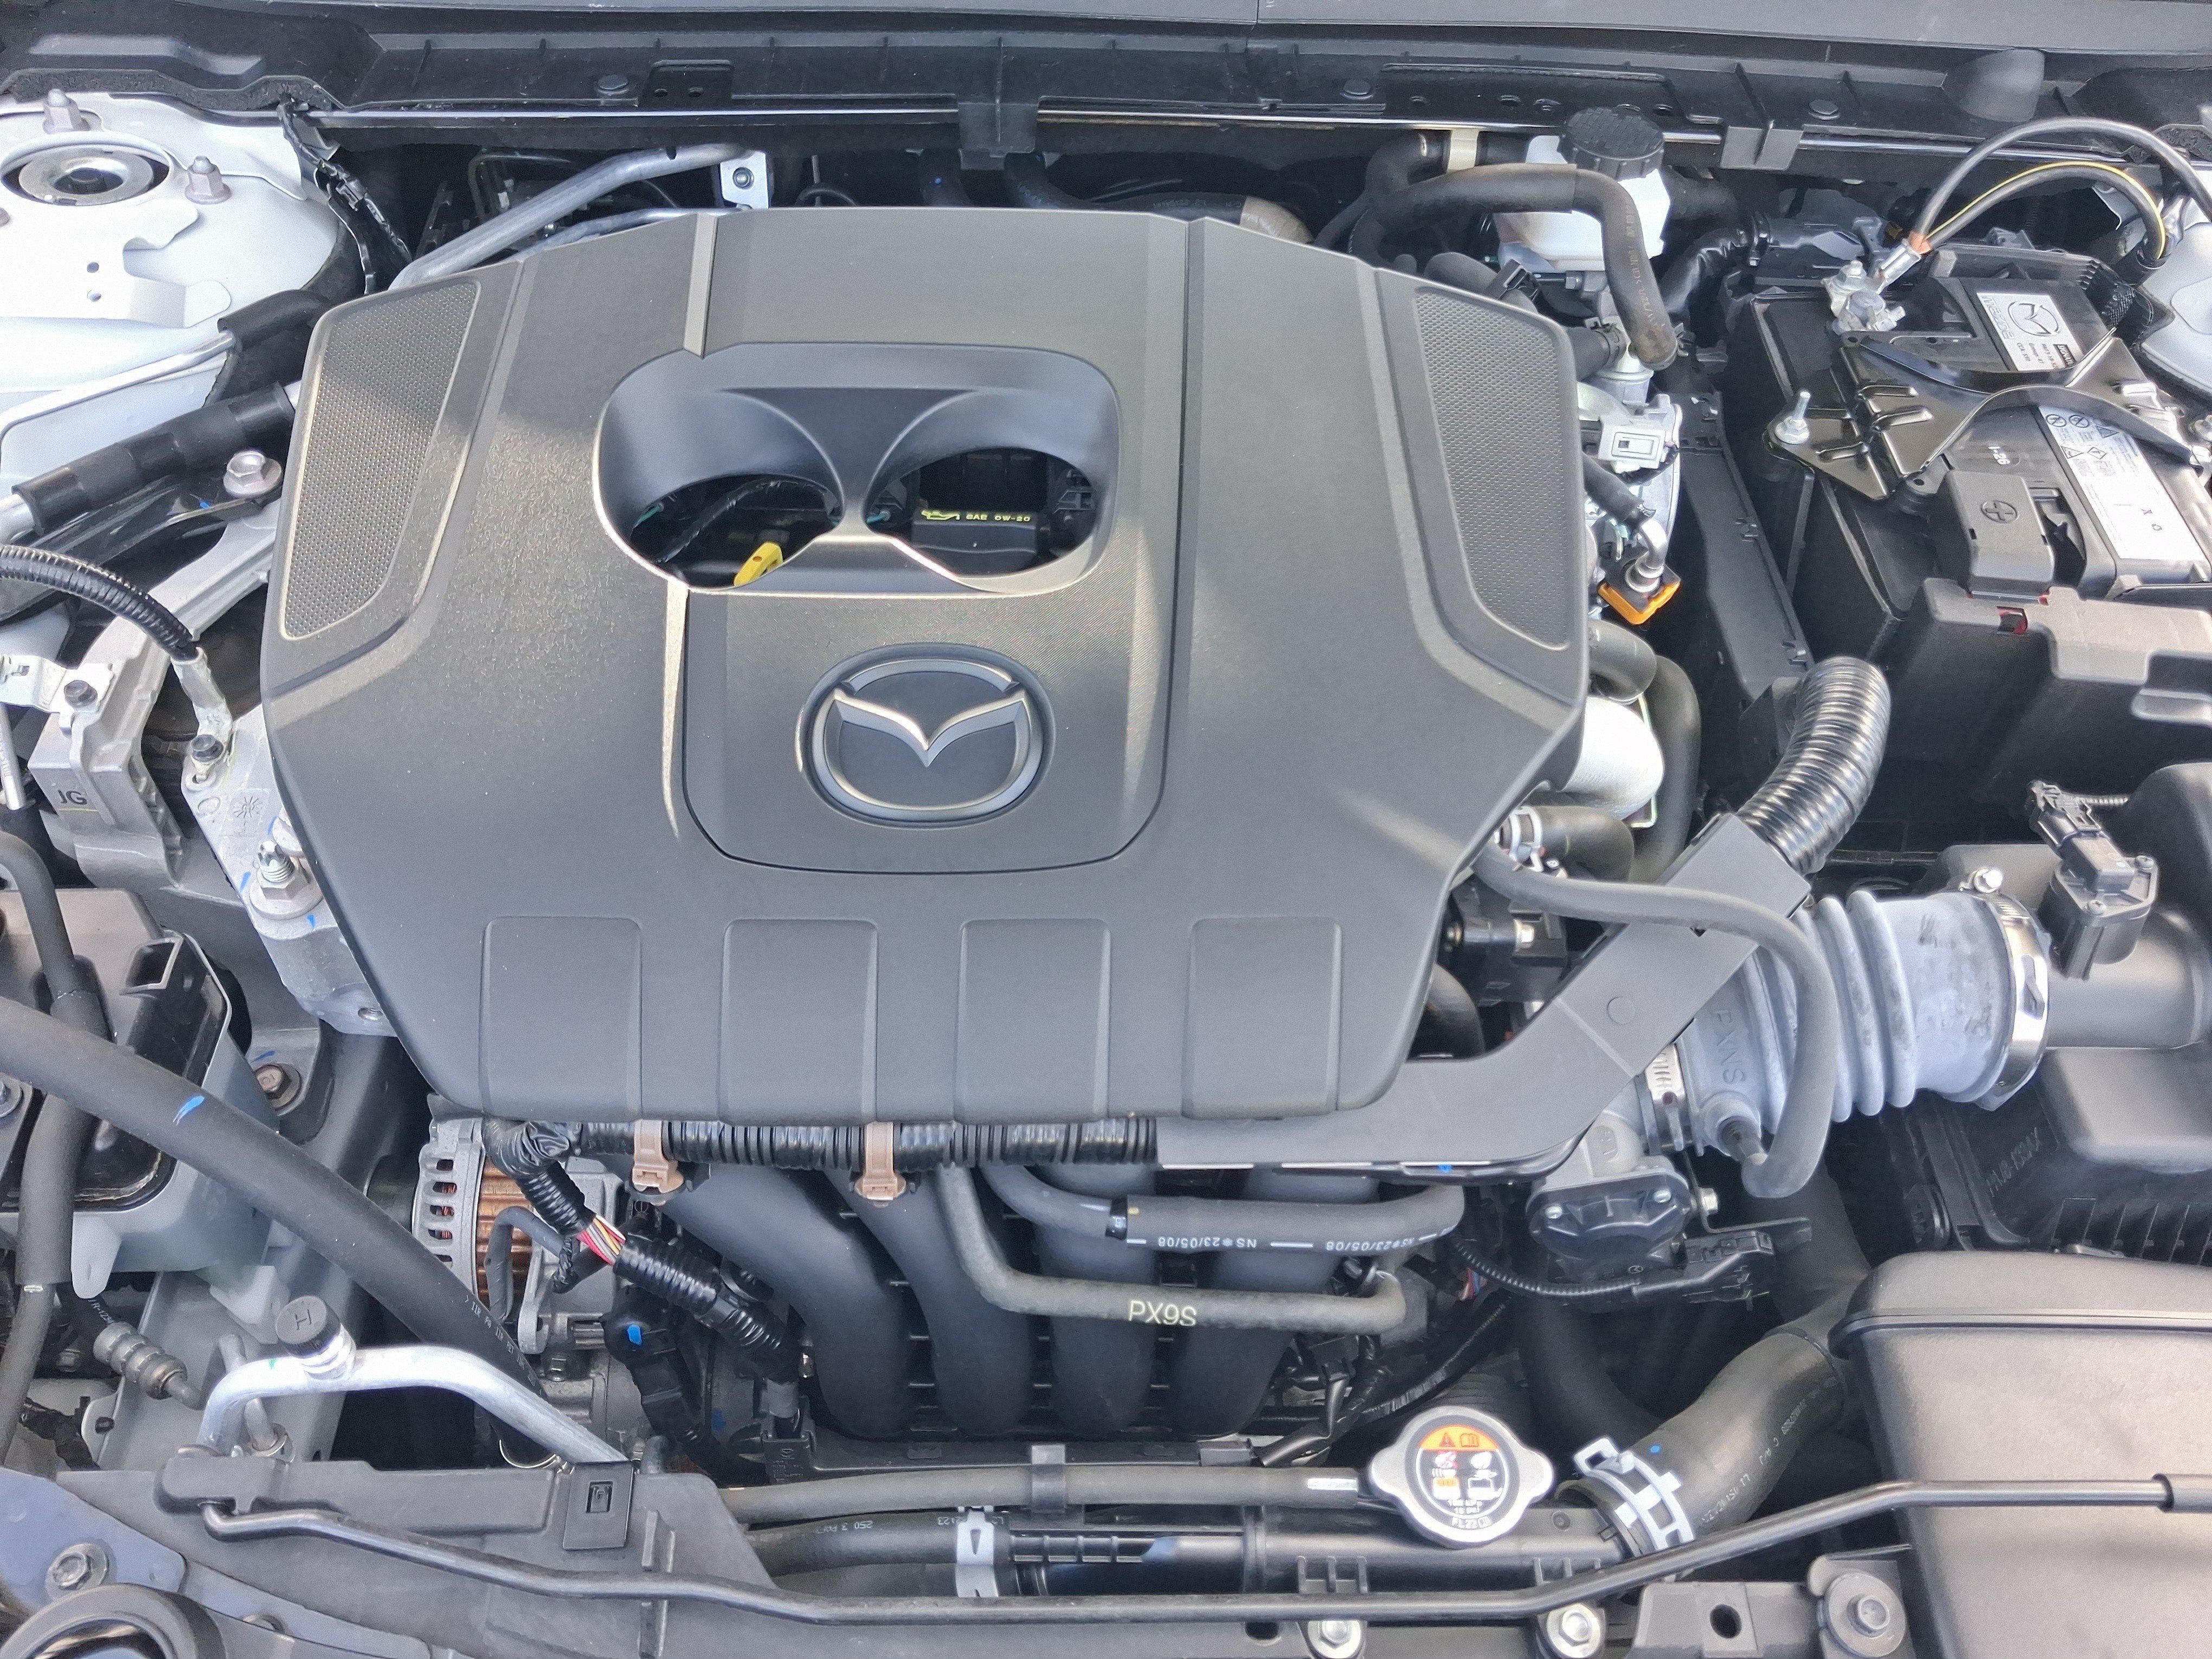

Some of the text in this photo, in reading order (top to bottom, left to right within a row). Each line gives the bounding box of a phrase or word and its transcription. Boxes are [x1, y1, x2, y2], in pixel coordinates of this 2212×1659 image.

[57, 790, 87, 805] JG
[295, 1308, 312, 1330] H
[1129, 1300, 1197, 1327] PX9S
[1451, 1517, 1478, 1529] FL22
